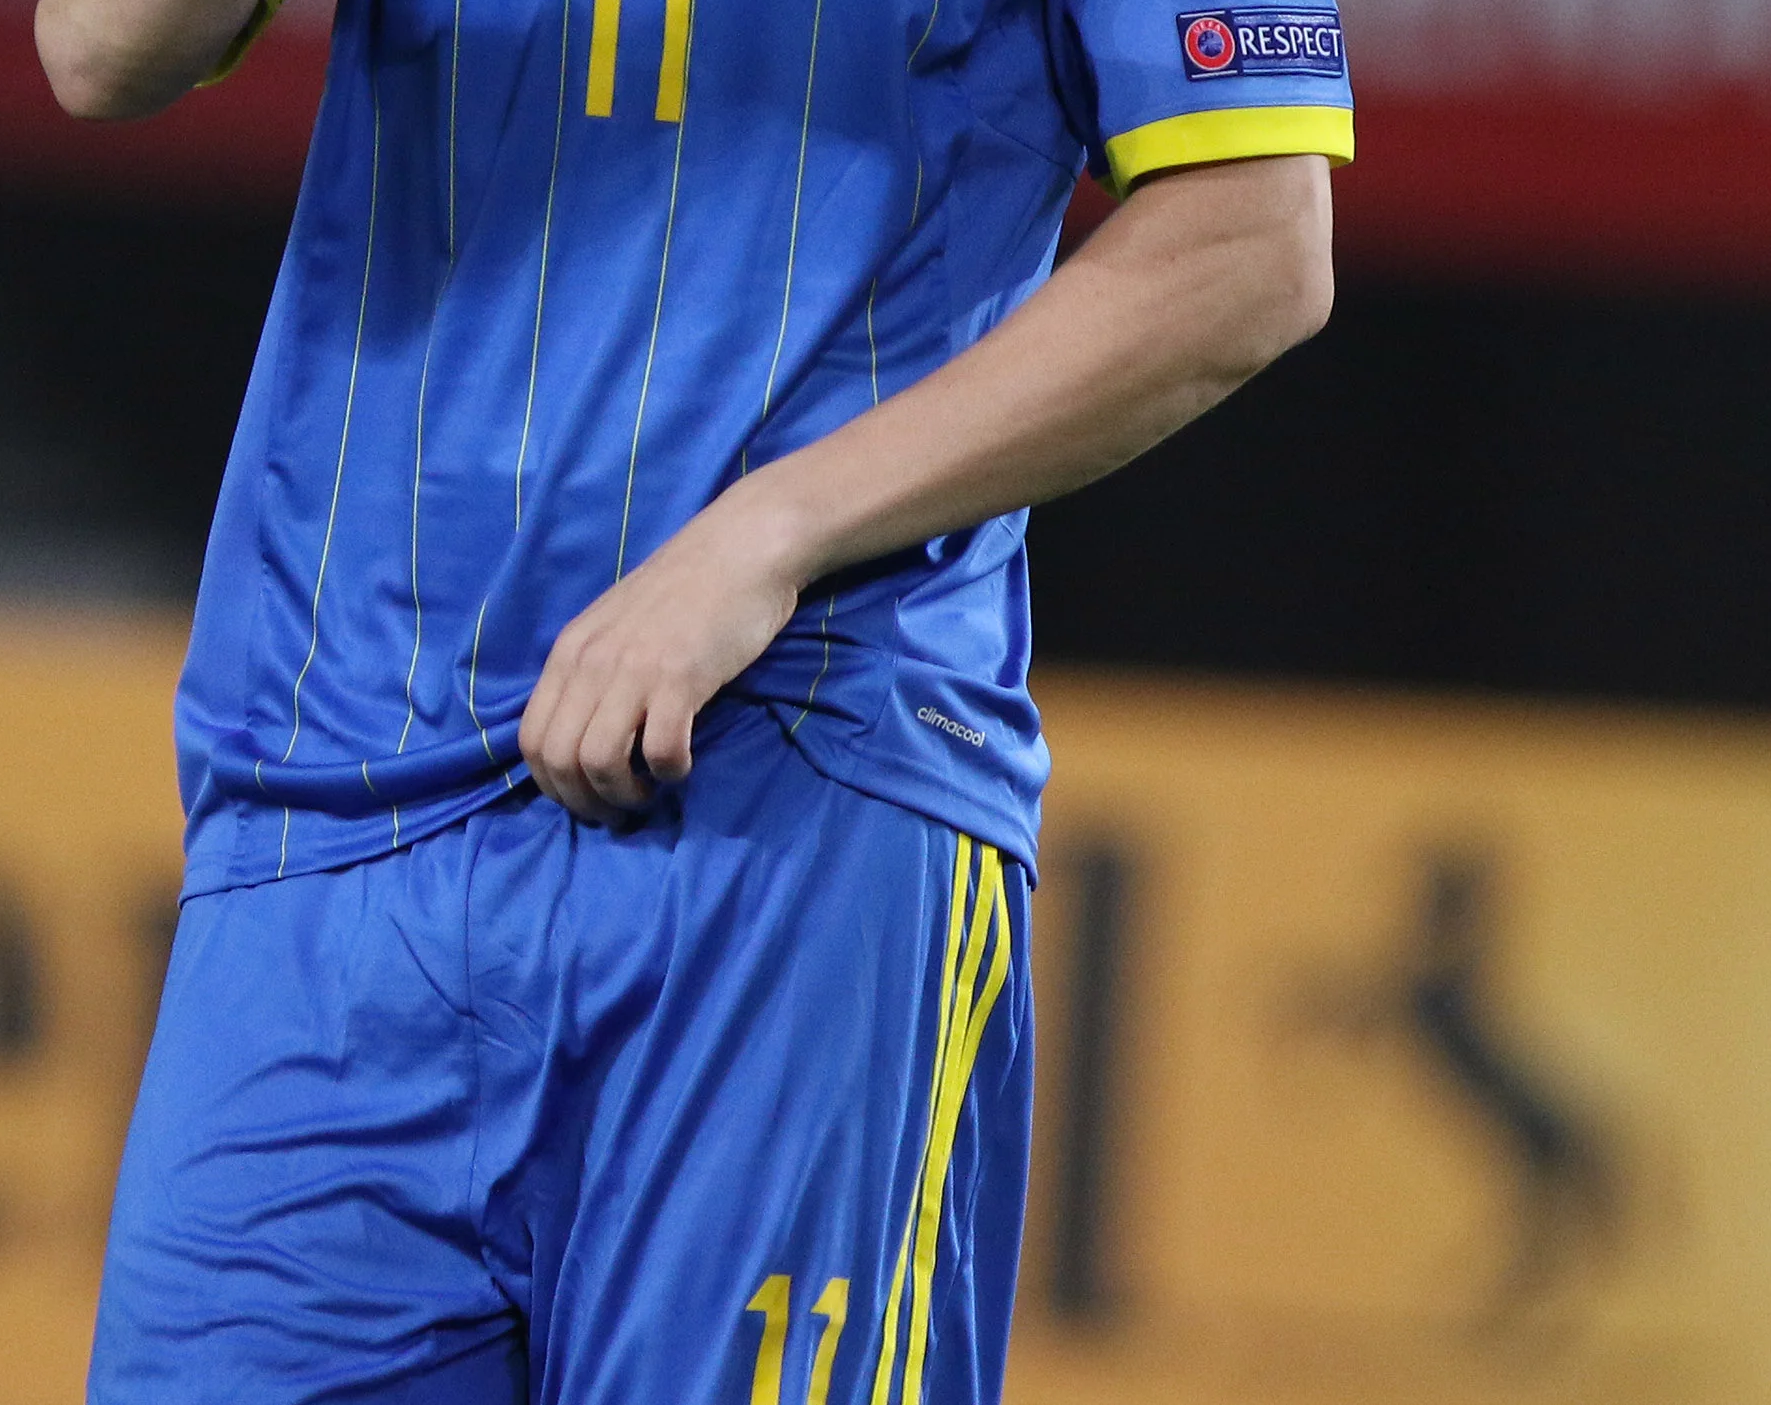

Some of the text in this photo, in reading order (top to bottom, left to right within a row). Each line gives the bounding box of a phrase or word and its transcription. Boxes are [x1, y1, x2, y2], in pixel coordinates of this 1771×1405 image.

[1238, 26, 1341, 57] RESPECT
[917, 706, 986, 748] climacool
[746, 1274, 851, 1405] 11
